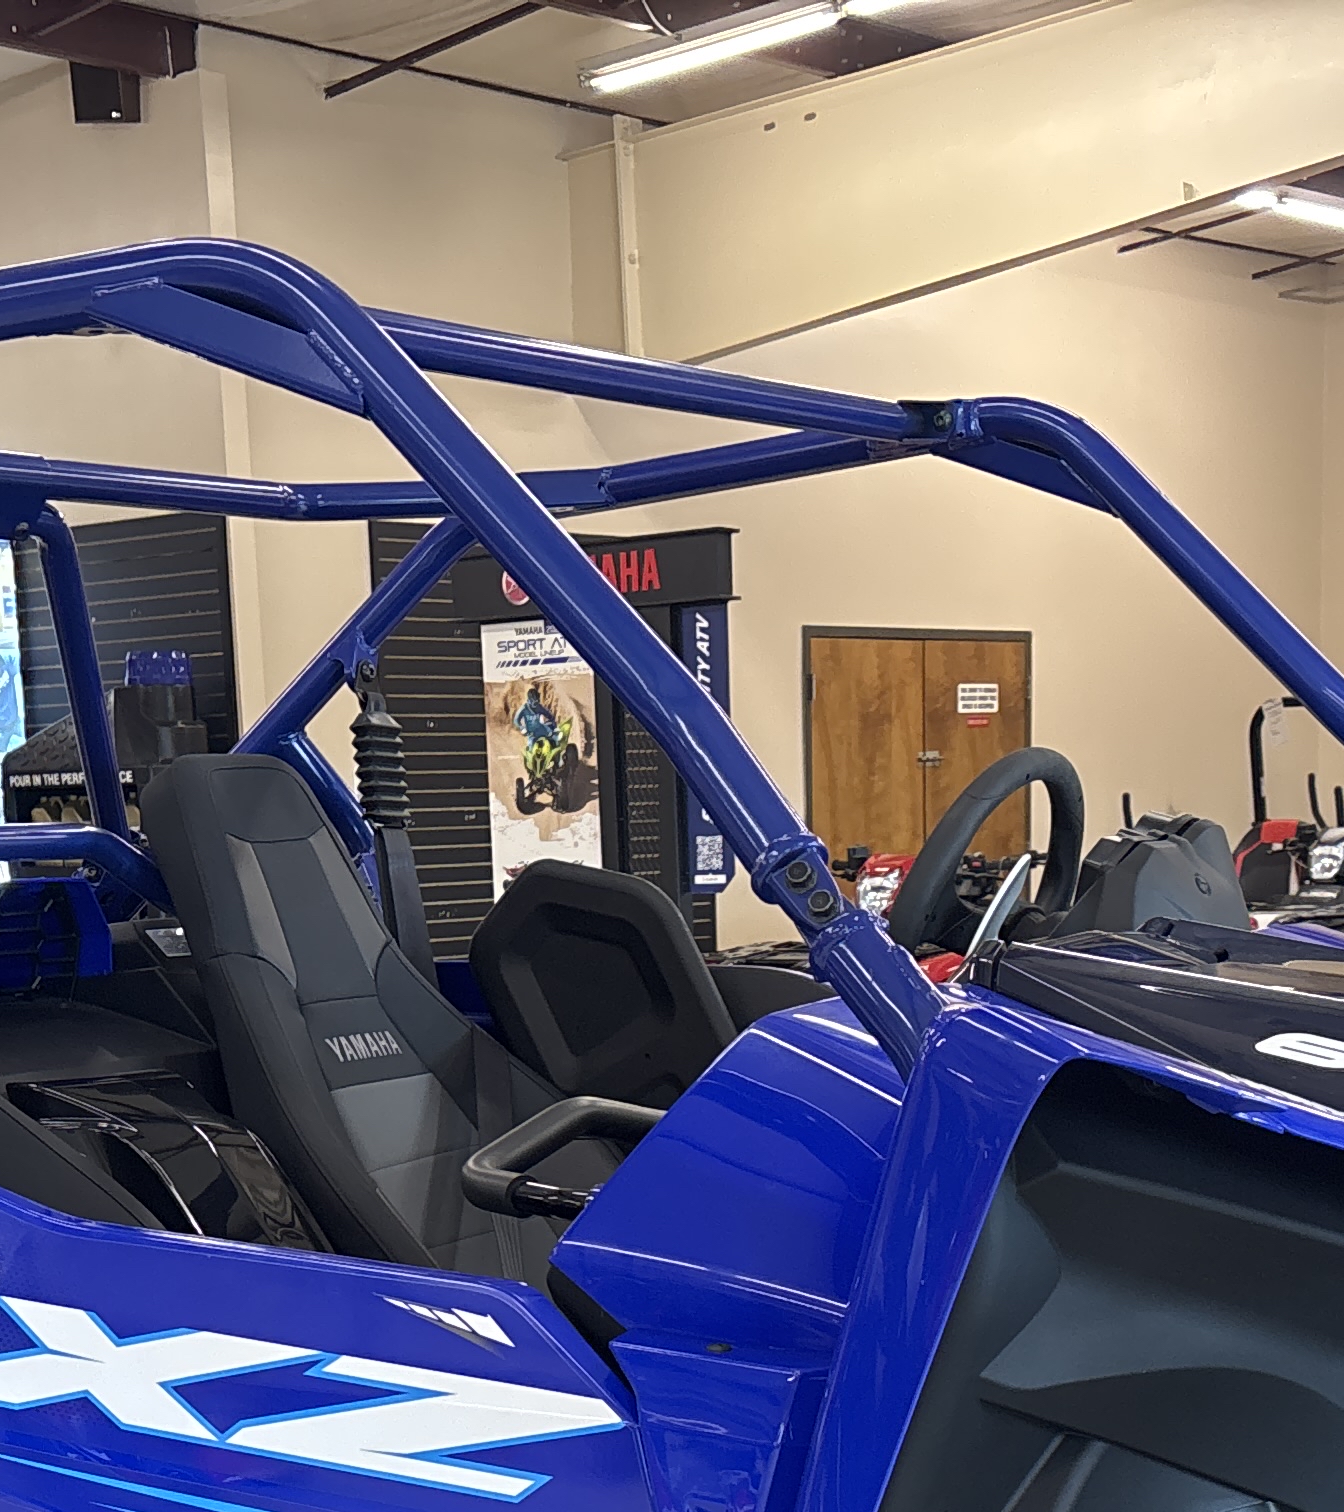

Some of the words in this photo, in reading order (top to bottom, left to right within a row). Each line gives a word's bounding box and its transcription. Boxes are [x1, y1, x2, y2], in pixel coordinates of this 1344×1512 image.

[590, 548, 661, 593] AHA
[514, 626, 543, 636] YAMAHA
[695, 612, 711, 657] ATV
[497, 637, 546, 653] SPORT
[551, 636, 567, 650] AT
[9, 774, 32, 788] POUR
[32, 773, 42, 787] IN
[42, 773, 61, 786] THE
[324, 1030, 403, 1063] YAMAHA
